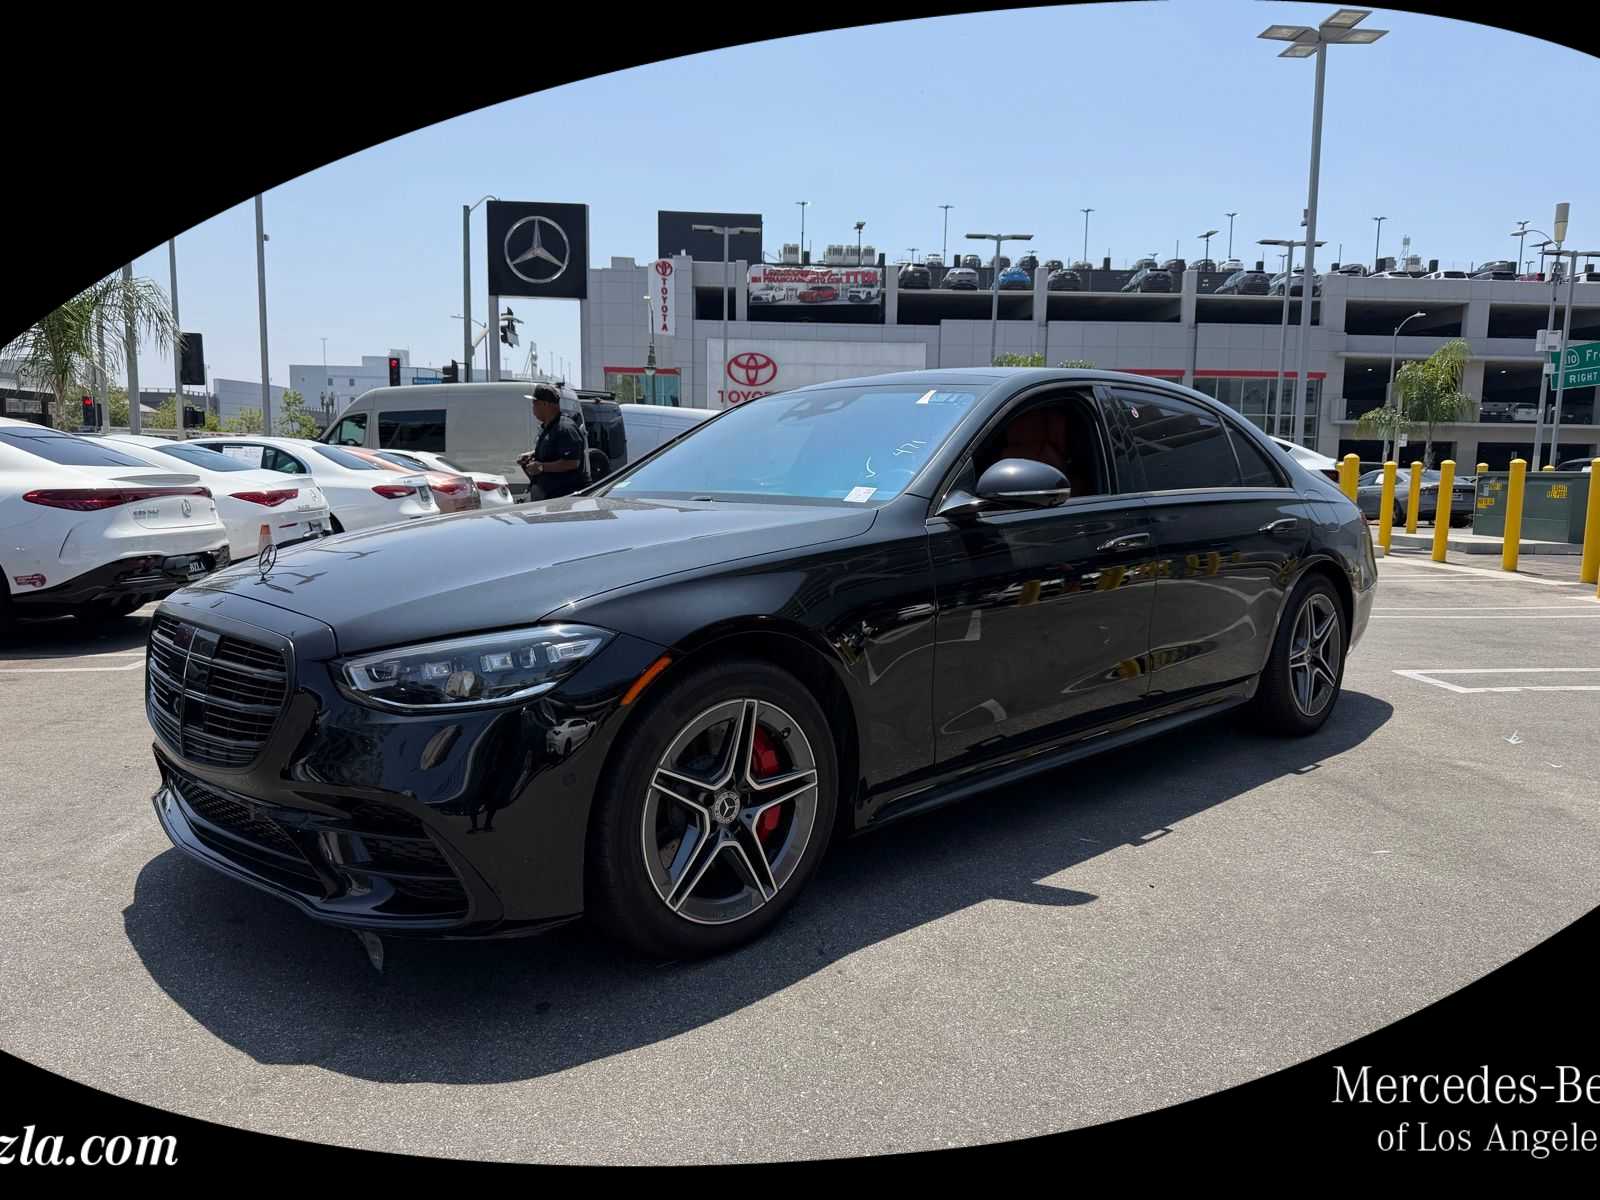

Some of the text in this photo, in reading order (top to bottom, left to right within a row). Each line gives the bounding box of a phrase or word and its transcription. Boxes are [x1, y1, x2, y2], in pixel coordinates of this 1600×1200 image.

[660, 277, 669, 332] TOYOTA
[1567, 349, 1600, 365] 10 Fr
[1569, 371, 1598, 384] RIGHT
